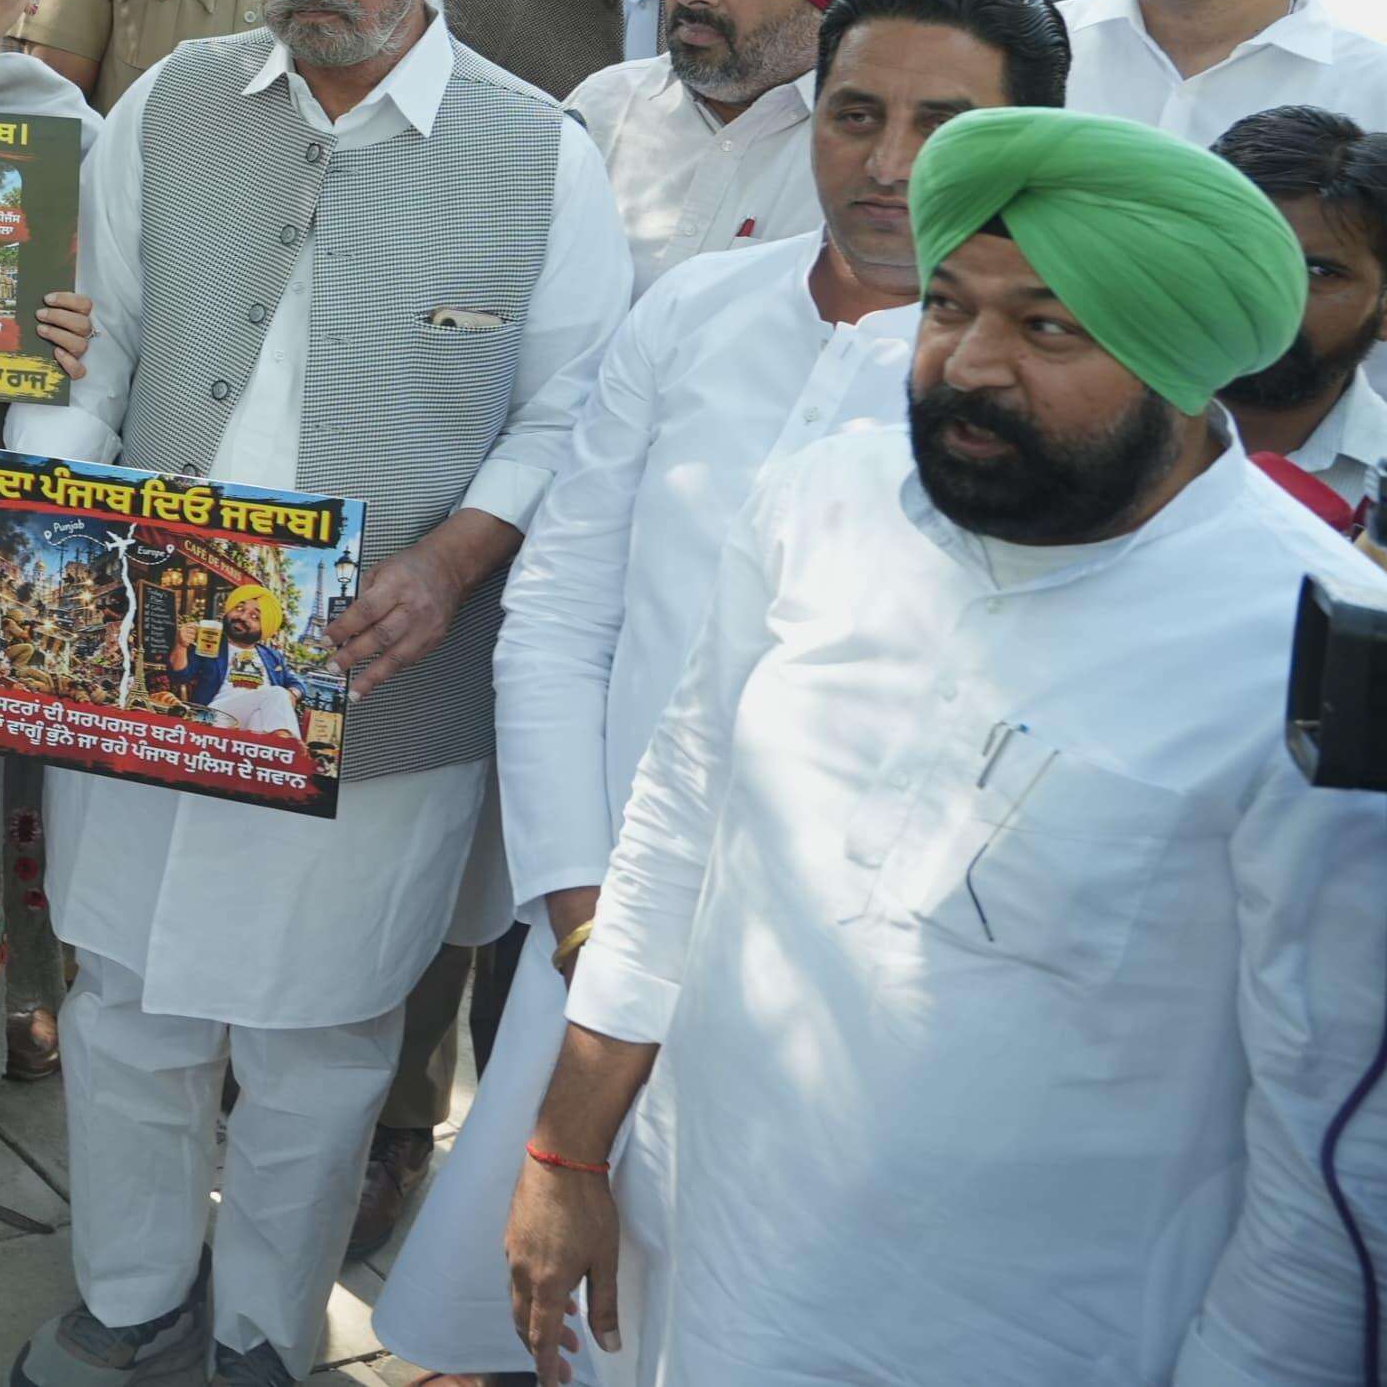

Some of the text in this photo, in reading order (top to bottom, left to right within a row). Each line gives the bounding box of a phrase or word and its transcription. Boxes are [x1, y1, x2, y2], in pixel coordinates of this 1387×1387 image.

[8, 370, 47, 391] ਰਾਜ
[41, 467, 135, 514] ਪੰਜਾਬ
[141, 481, 215, 520] ਦਿਓ
[220, 497, 330, 542] ਜਵਾਬ।
[54, 520, 85, 535] Punjab
[137, 546, 166, 558] Europe
[7, 718, 45, 745] ਵਾਂਗੂੰ
[46, 723, 75, 746] ਭੁੰਨੇ
[132, 739, 180, 765] ਪੰਜਾਬ
[184, 751, 234, 776] ਪੁਲਿਸ
[238, 759, 253, 779] ਦੇ
[256, 767, 307, 789] ਜਵਾਨ
[43, 702, 64, 722] ਦੀ
[67, 710, 147, 737] ਸਰਪਰਸਤ
[151, 724, 187, 744] ਬਣੀ
[190, 732, 228, 752] ਆਪ
[231, 740, 295, 765] ਸਰਕਾਰ
